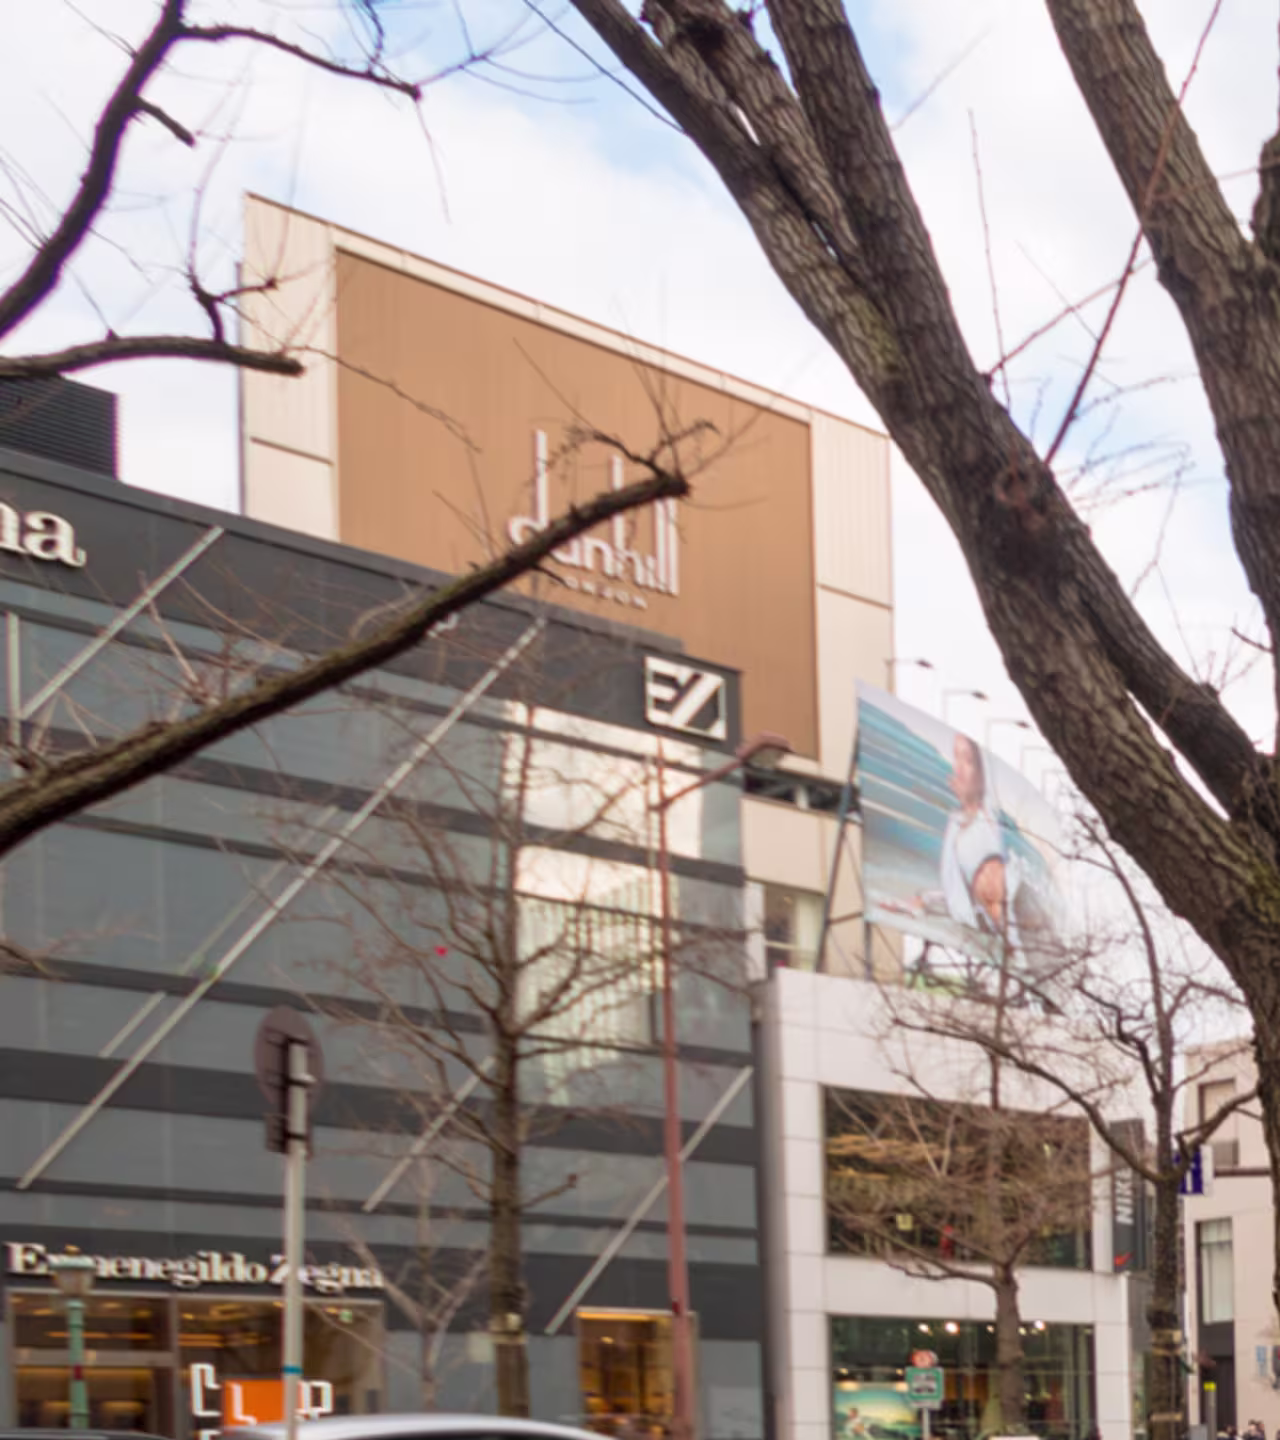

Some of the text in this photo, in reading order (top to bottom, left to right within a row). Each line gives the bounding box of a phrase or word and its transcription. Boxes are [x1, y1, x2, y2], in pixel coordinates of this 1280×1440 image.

[508, 428, 680, 596] dunhill
[563, 575, 648, 610] ONDON
[1114, 1167, 1135, 1226] NIKE
[5, 1241, 268, 1289] Eenegildo
